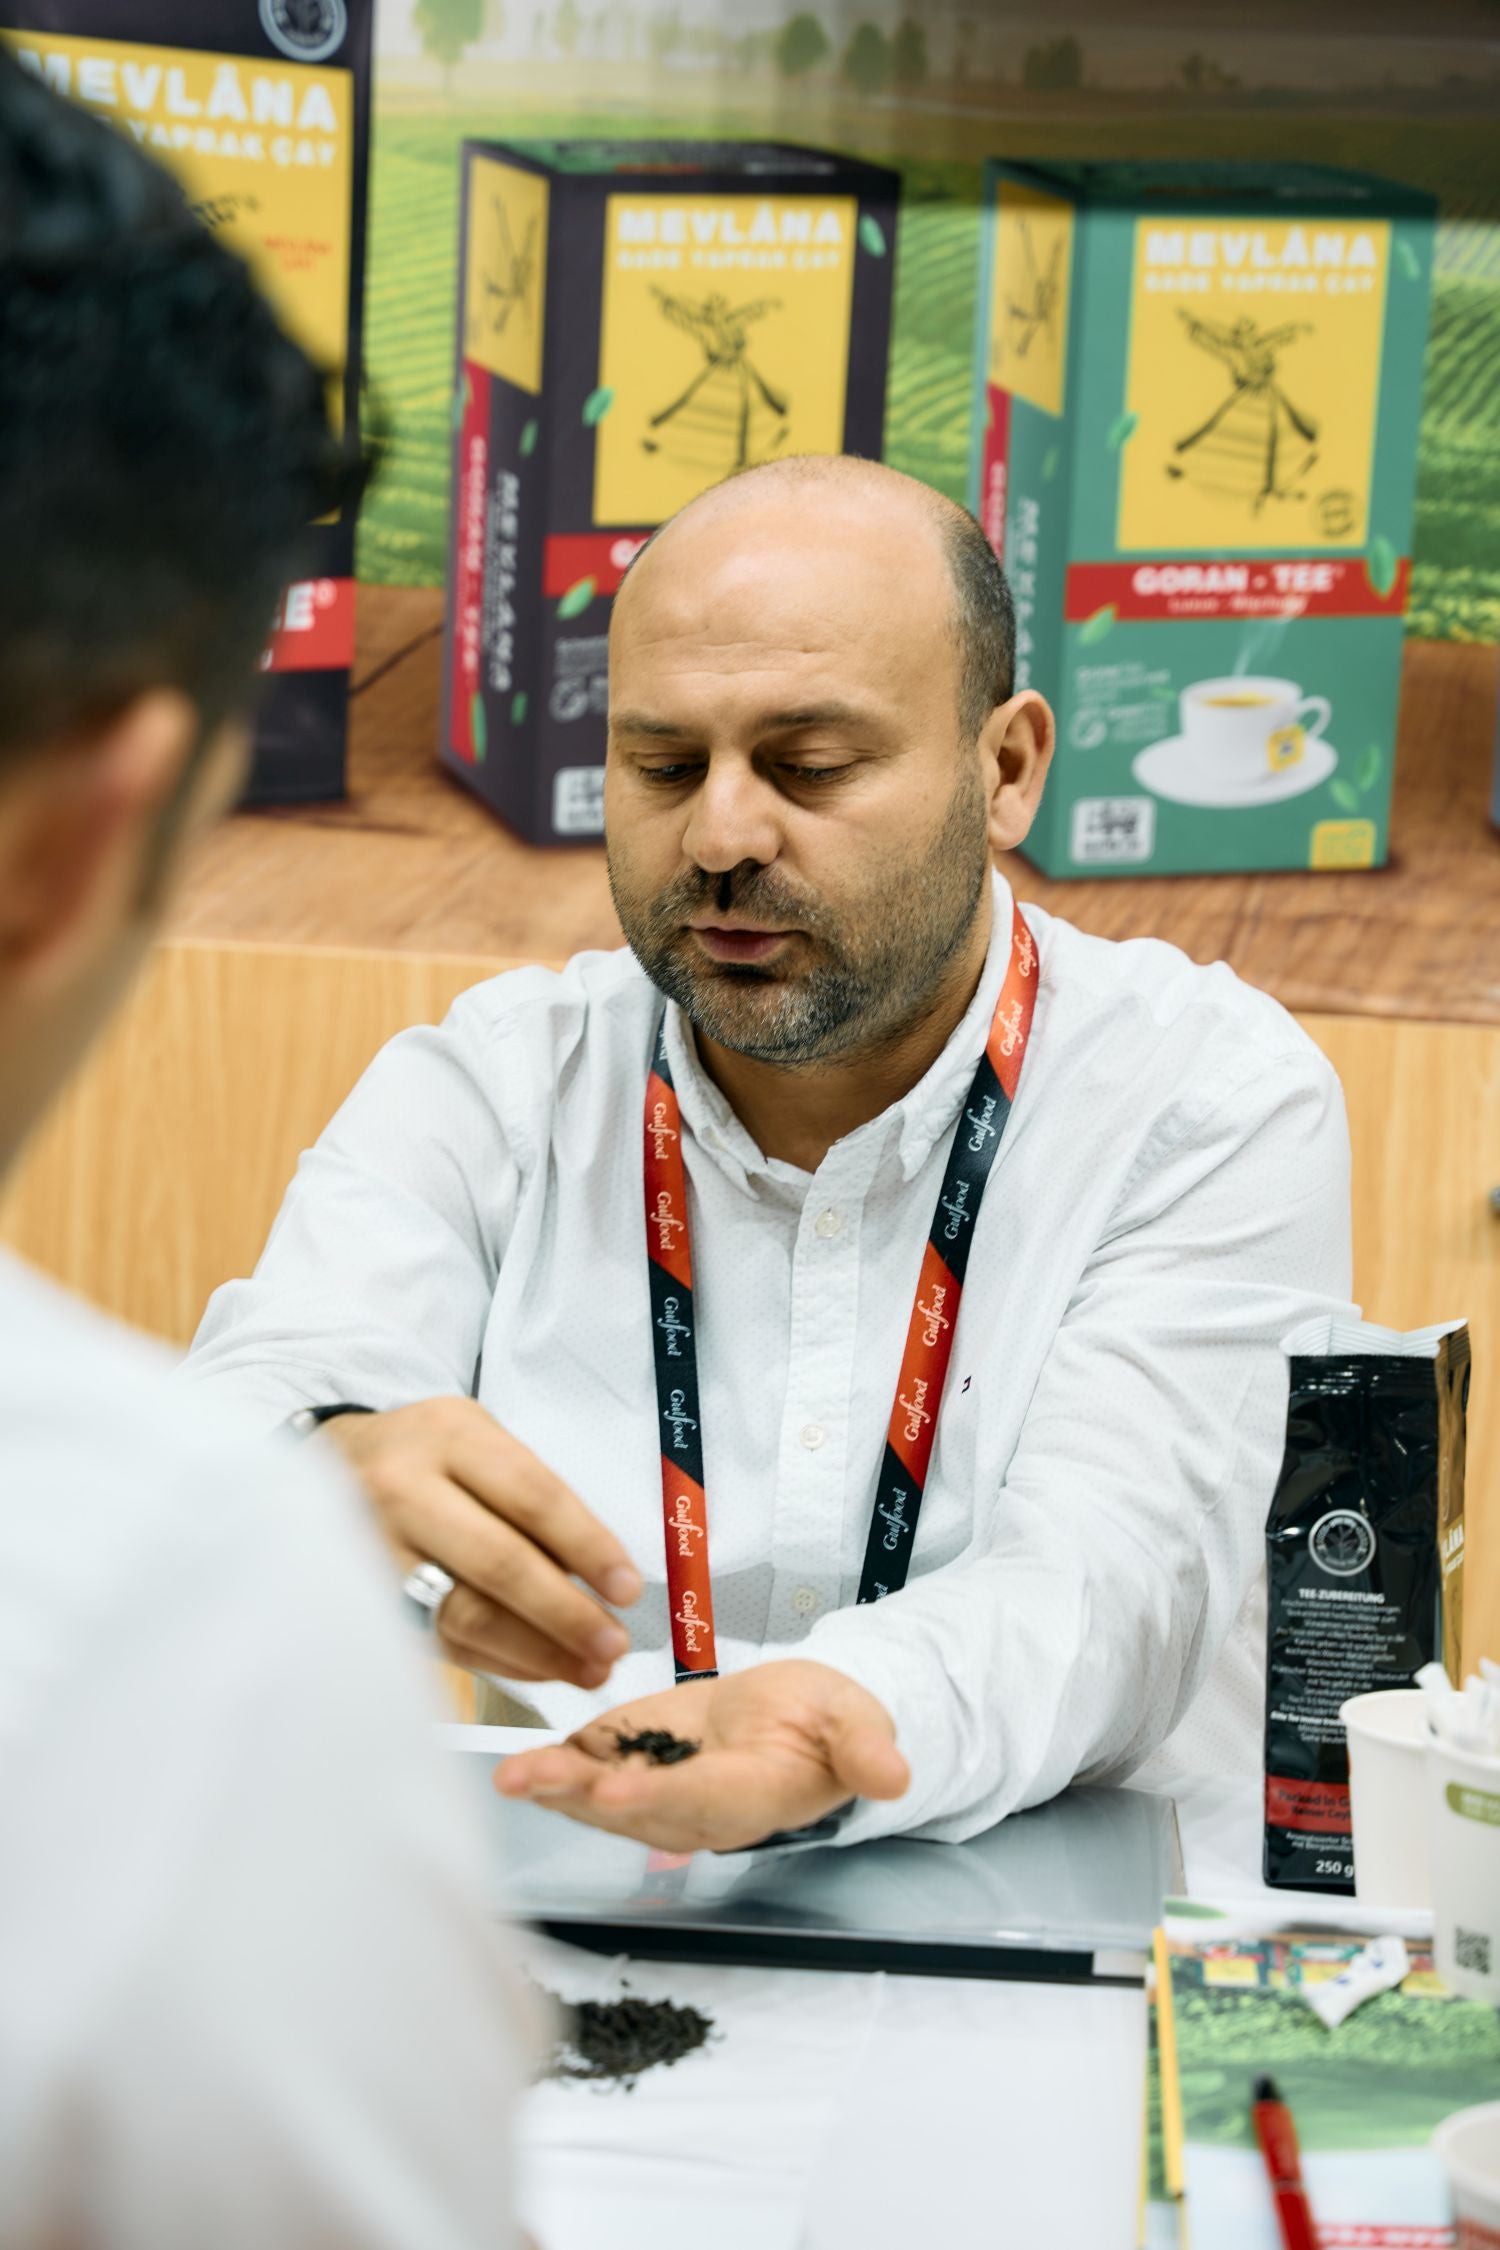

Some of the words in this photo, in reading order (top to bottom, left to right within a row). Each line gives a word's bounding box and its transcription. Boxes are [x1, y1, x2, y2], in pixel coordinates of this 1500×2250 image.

[617, 199, 842, 245] MEVLÂNA
[1145, 224, 1377, 267] MEVLÂNA
[997, 999, 1025, 1058] Gulfood
[648, 1102, 677, 1161] Gulfood
[966, 1094, 998, 1153] Gulfood
[651, 1191, 685, 1251] Gulfood
[941, 1179, 971, 1241] Gulfood
[656, 1296, 692, 1357] Gulfood
[917, 1283, 950, 1348] Gulfood
[662, 1388, 698, 1450] Gulfood
[898, 1377, 932, 1442] Gulfood
[667, 1494, 704, 1558] Gulfood
[877, 1486, 910, 1552] Gulfood
[674, 1589, 710, 1654] Gulfood
[1315, 1860, 1342, 1874] 250
